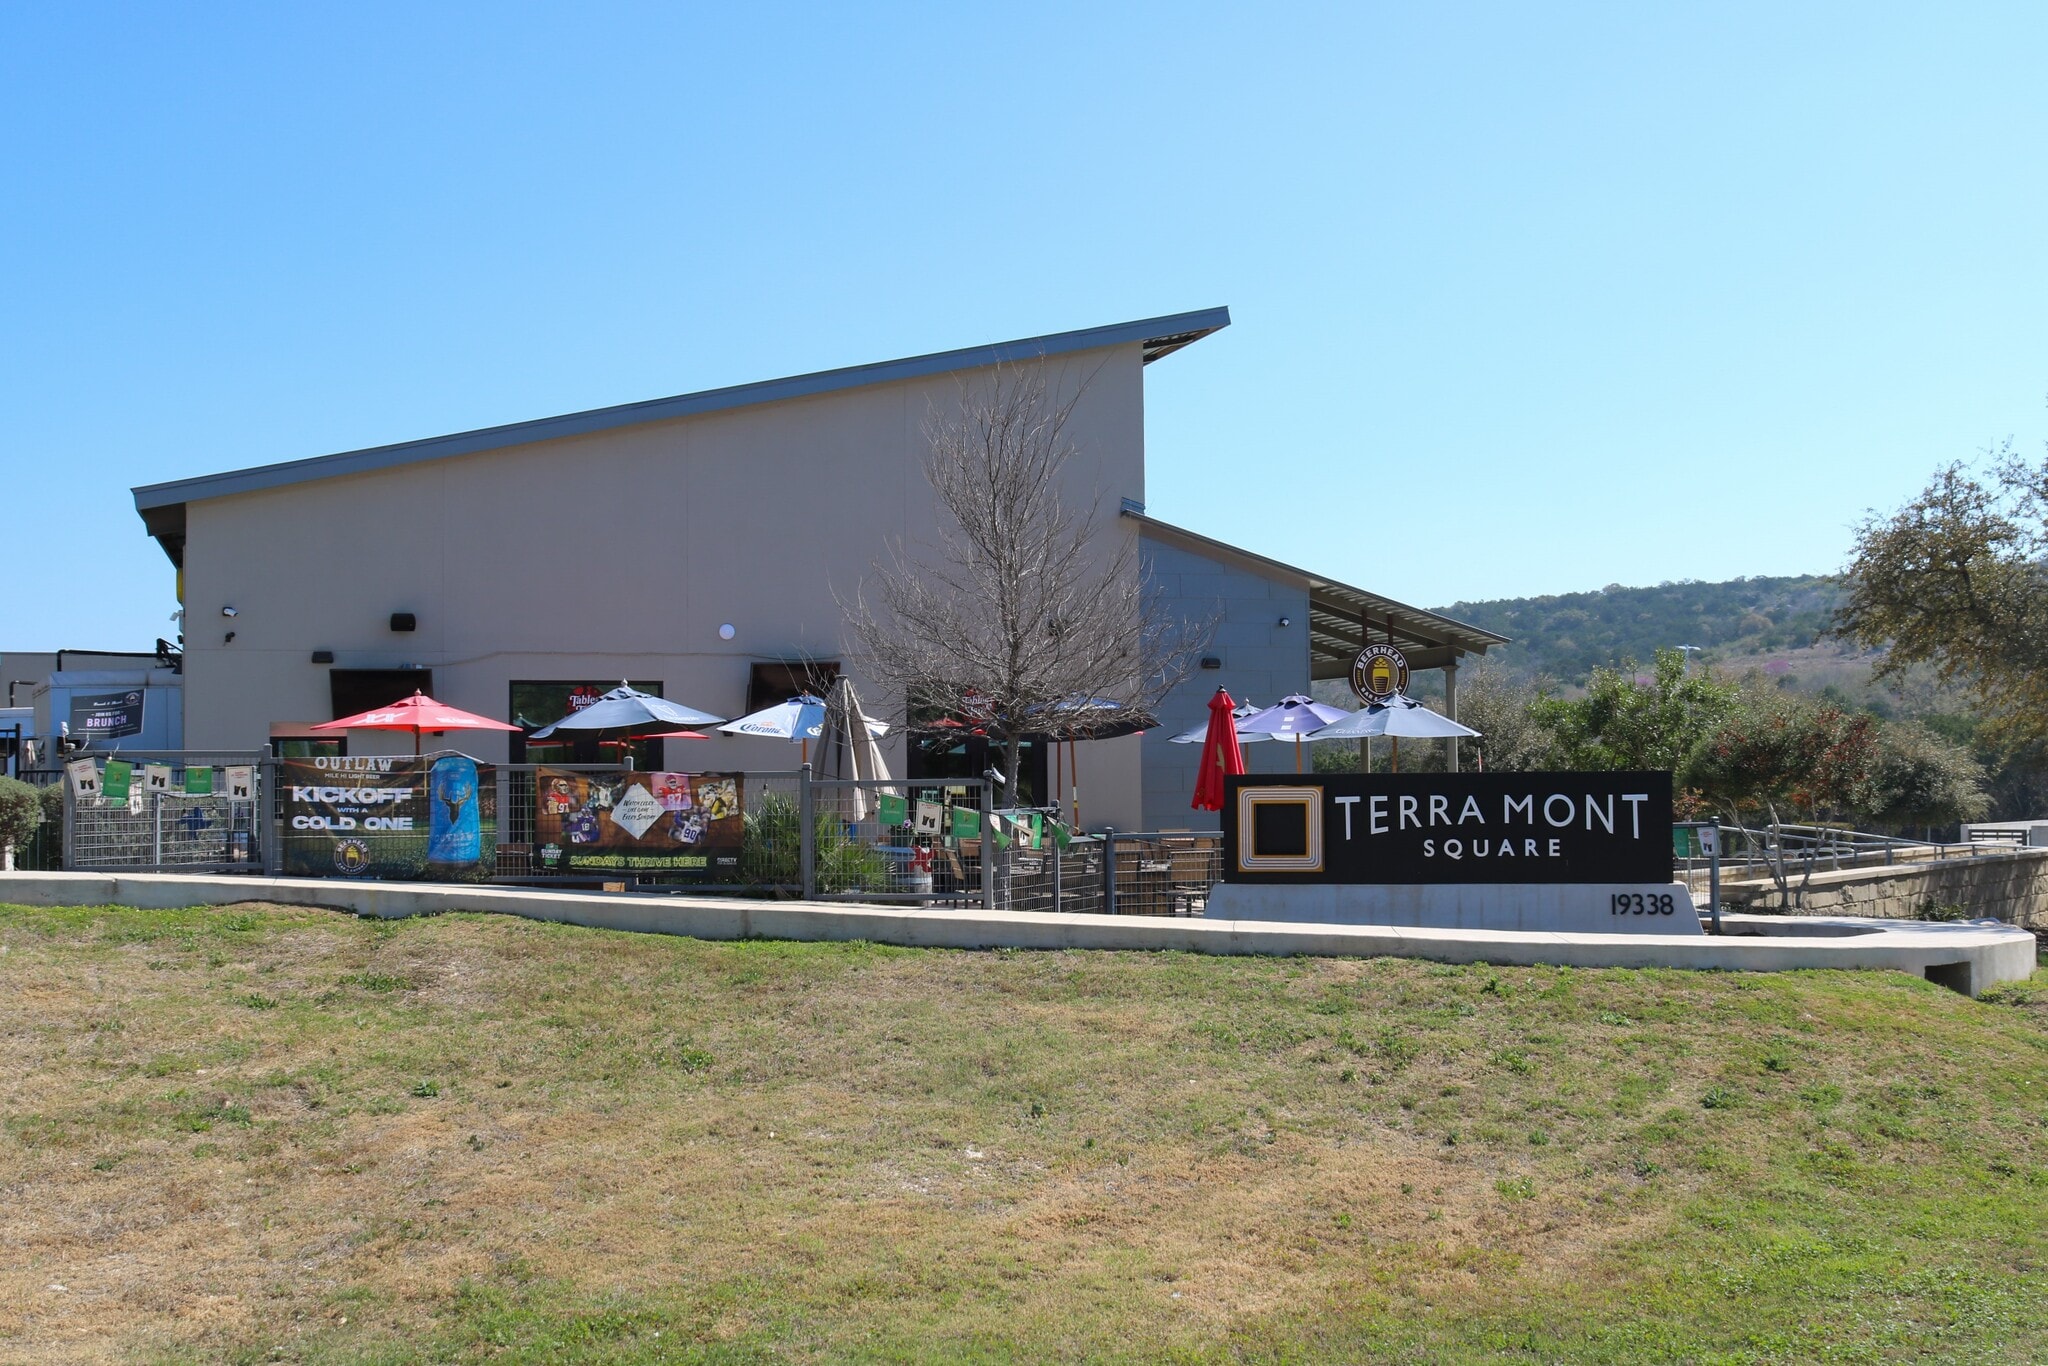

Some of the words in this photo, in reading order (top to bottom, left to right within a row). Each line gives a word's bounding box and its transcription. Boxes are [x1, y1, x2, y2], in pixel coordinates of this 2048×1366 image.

[1356, 647, 1404, 670] BEERHEAD
[1361, 687, 1373, 699] BAR
[86, 715, 127, 727] BRUNCH
[740, 723, 780, 734] Corona
[314, 756, 393, 771] OUTLAW
[292, 786, 413, 804] KICKOFF
[292, 816, 357, 830] COLD
[364, 816, 413, 831] ONE
[1335, 795, 1484, 841] TERRA
[1504, 793, 1648, 840] MONT
[684, 828, 697, 840] 90
[1423, 838, 1561, 860] SQUARE
[569, 855, 625, 867] SUNDAYS
[627, 856, 671, 868] THRIVE
[673, 856, 707, 867] HERE
[1611, 894, 1675, 916] 19338
